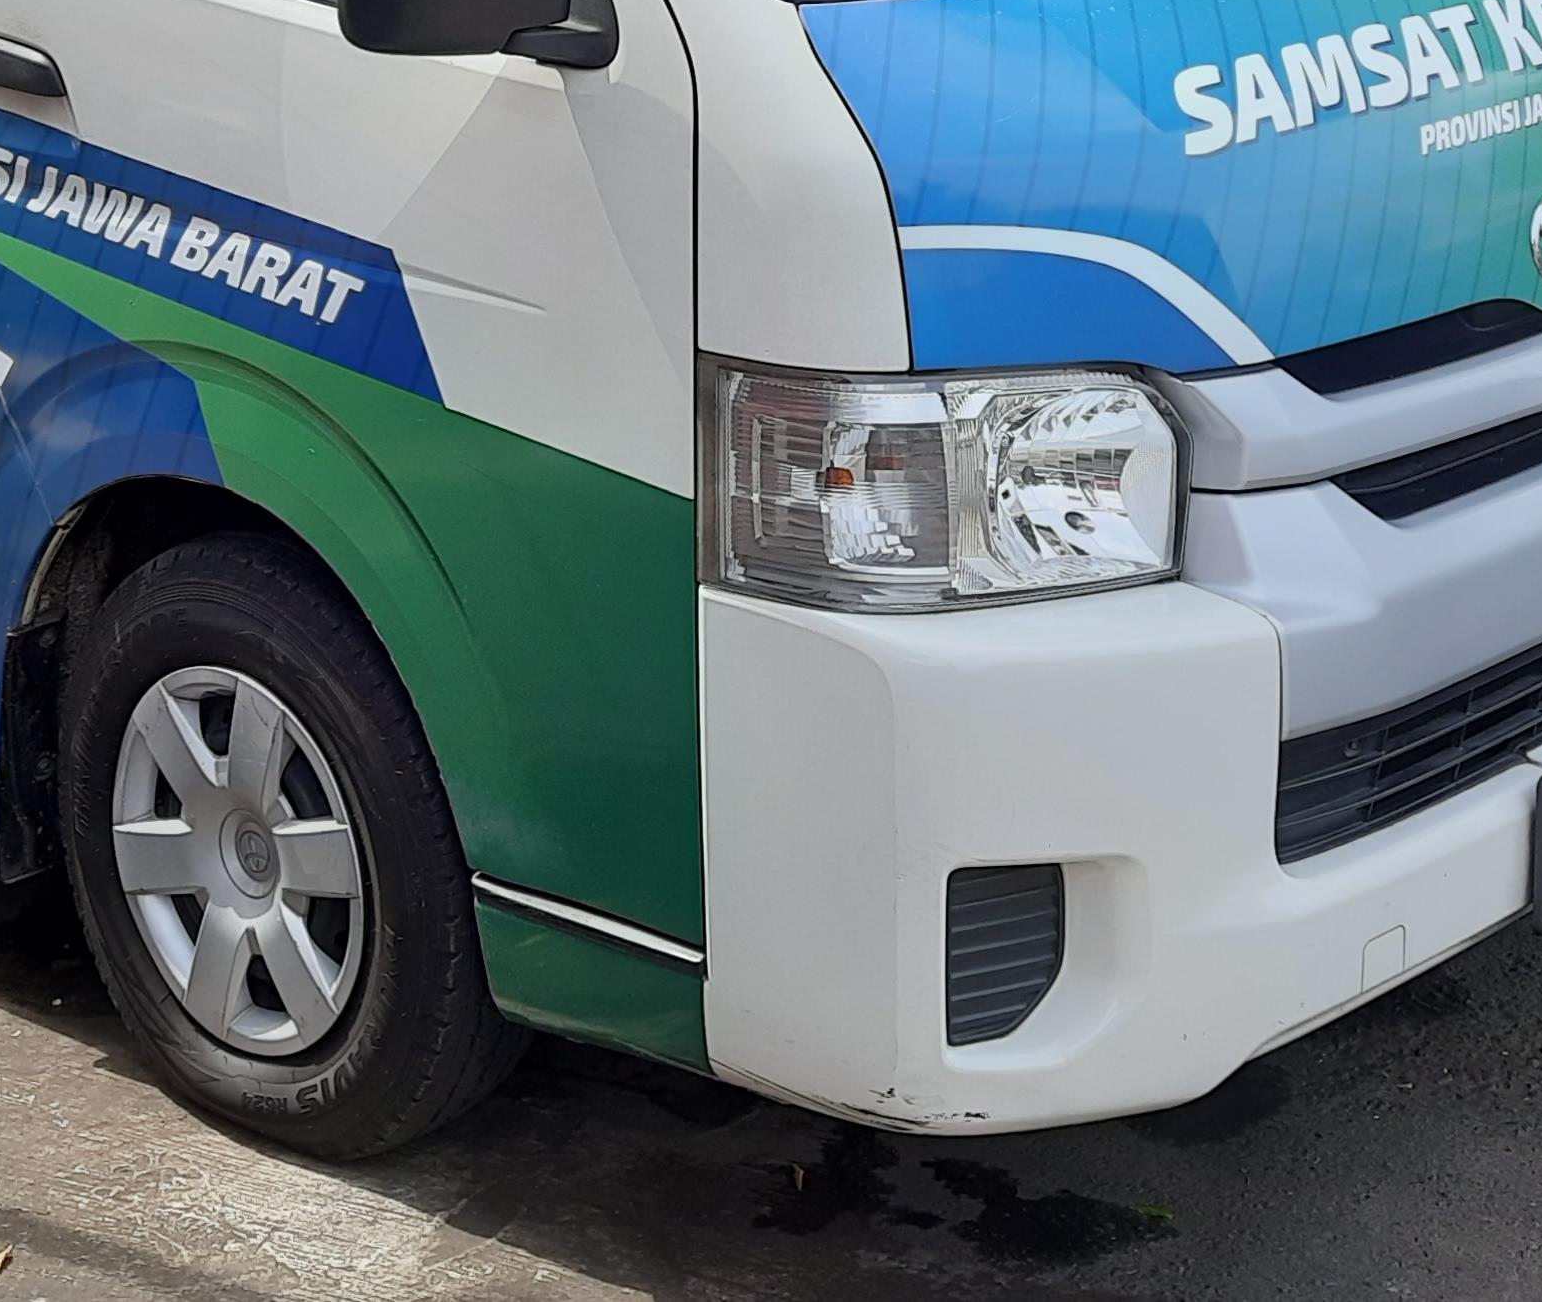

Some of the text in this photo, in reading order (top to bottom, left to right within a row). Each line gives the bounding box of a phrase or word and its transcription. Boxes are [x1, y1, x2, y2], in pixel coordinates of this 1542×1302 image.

[1172, 3, 1486, 157] SAMSAT
[1420, 103, 1522, 156] PROVINSI
[25, 165, 173, 258] JAWA
[170, 216, 366, 325] BARAT
